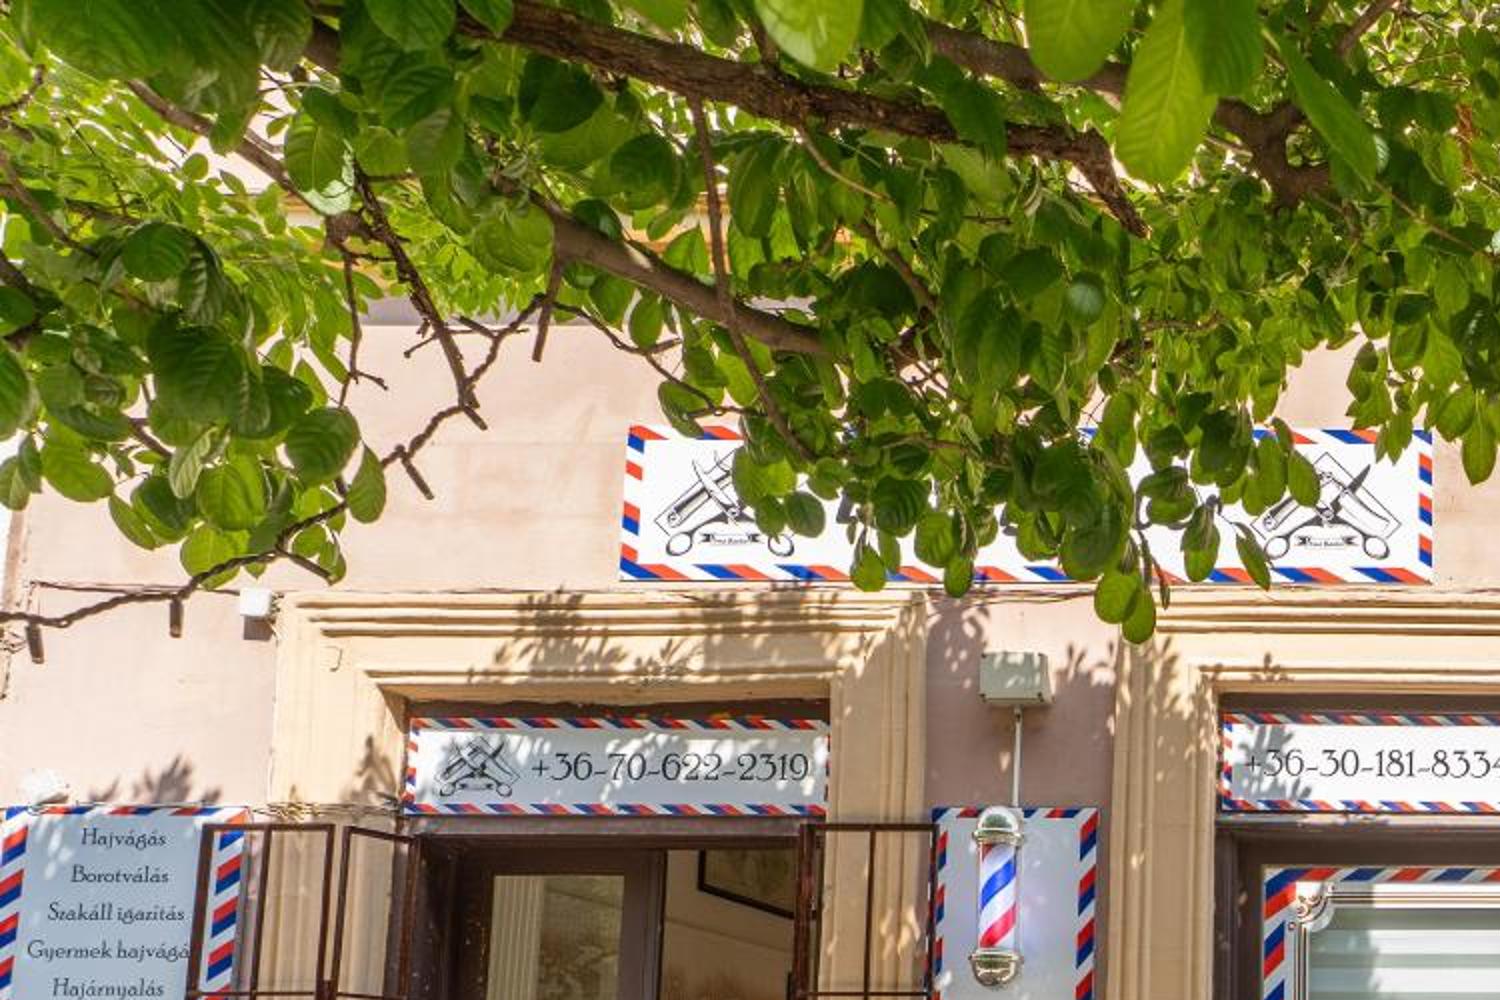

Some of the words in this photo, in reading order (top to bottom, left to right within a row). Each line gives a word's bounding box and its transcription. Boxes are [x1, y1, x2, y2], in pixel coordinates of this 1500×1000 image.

[532, 751, 809, 783] +36-70-622-2319
[81, 827, 167, 850] Hajvágás
[71, 864, 169, 883] Borotválás
[48, 901, 113, 921] Szakáll
[117, 904, 185, 924] igazítás
[27, 939, 112, 962] Gyermek
[117, 940, 191, 962] hajvágá
[52, 977, 165, 1000] Hajárnyalás
